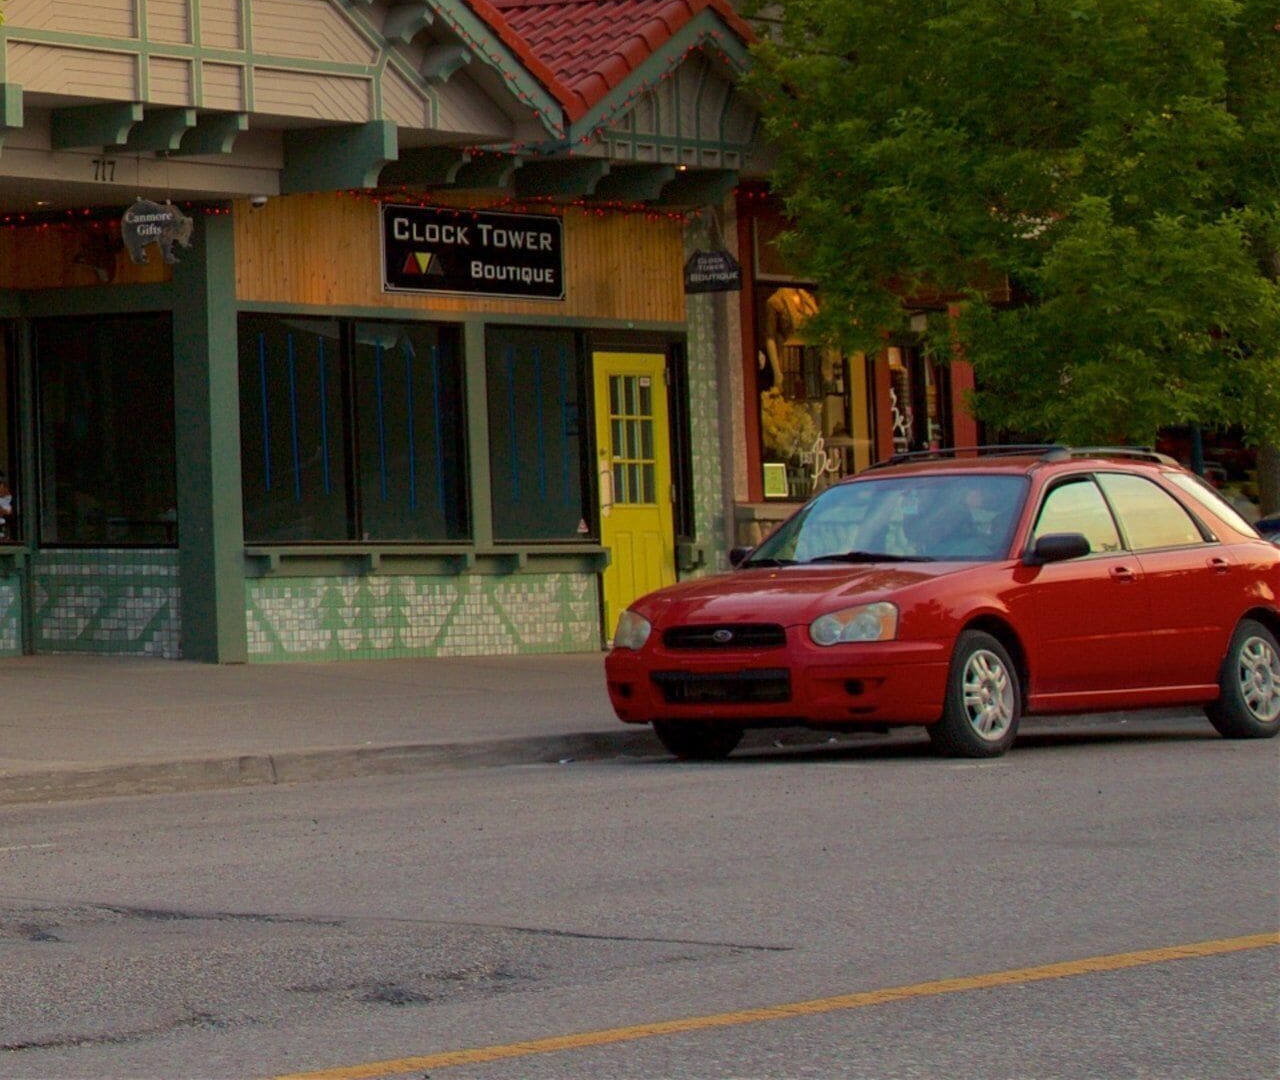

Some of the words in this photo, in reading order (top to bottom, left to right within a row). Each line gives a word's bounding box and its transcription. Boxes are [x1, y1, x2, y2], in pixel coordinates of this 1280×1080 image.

[91, 159, 117, 182] 717
[127, 211, 174, 224] Canmore
[136, 223, 163, 237] Gifts
[393, 218, 470, 246] CLOCK
[476, 223, 553, 252] TOWER
[470, 261, 554, 286] BOUTIQUE
